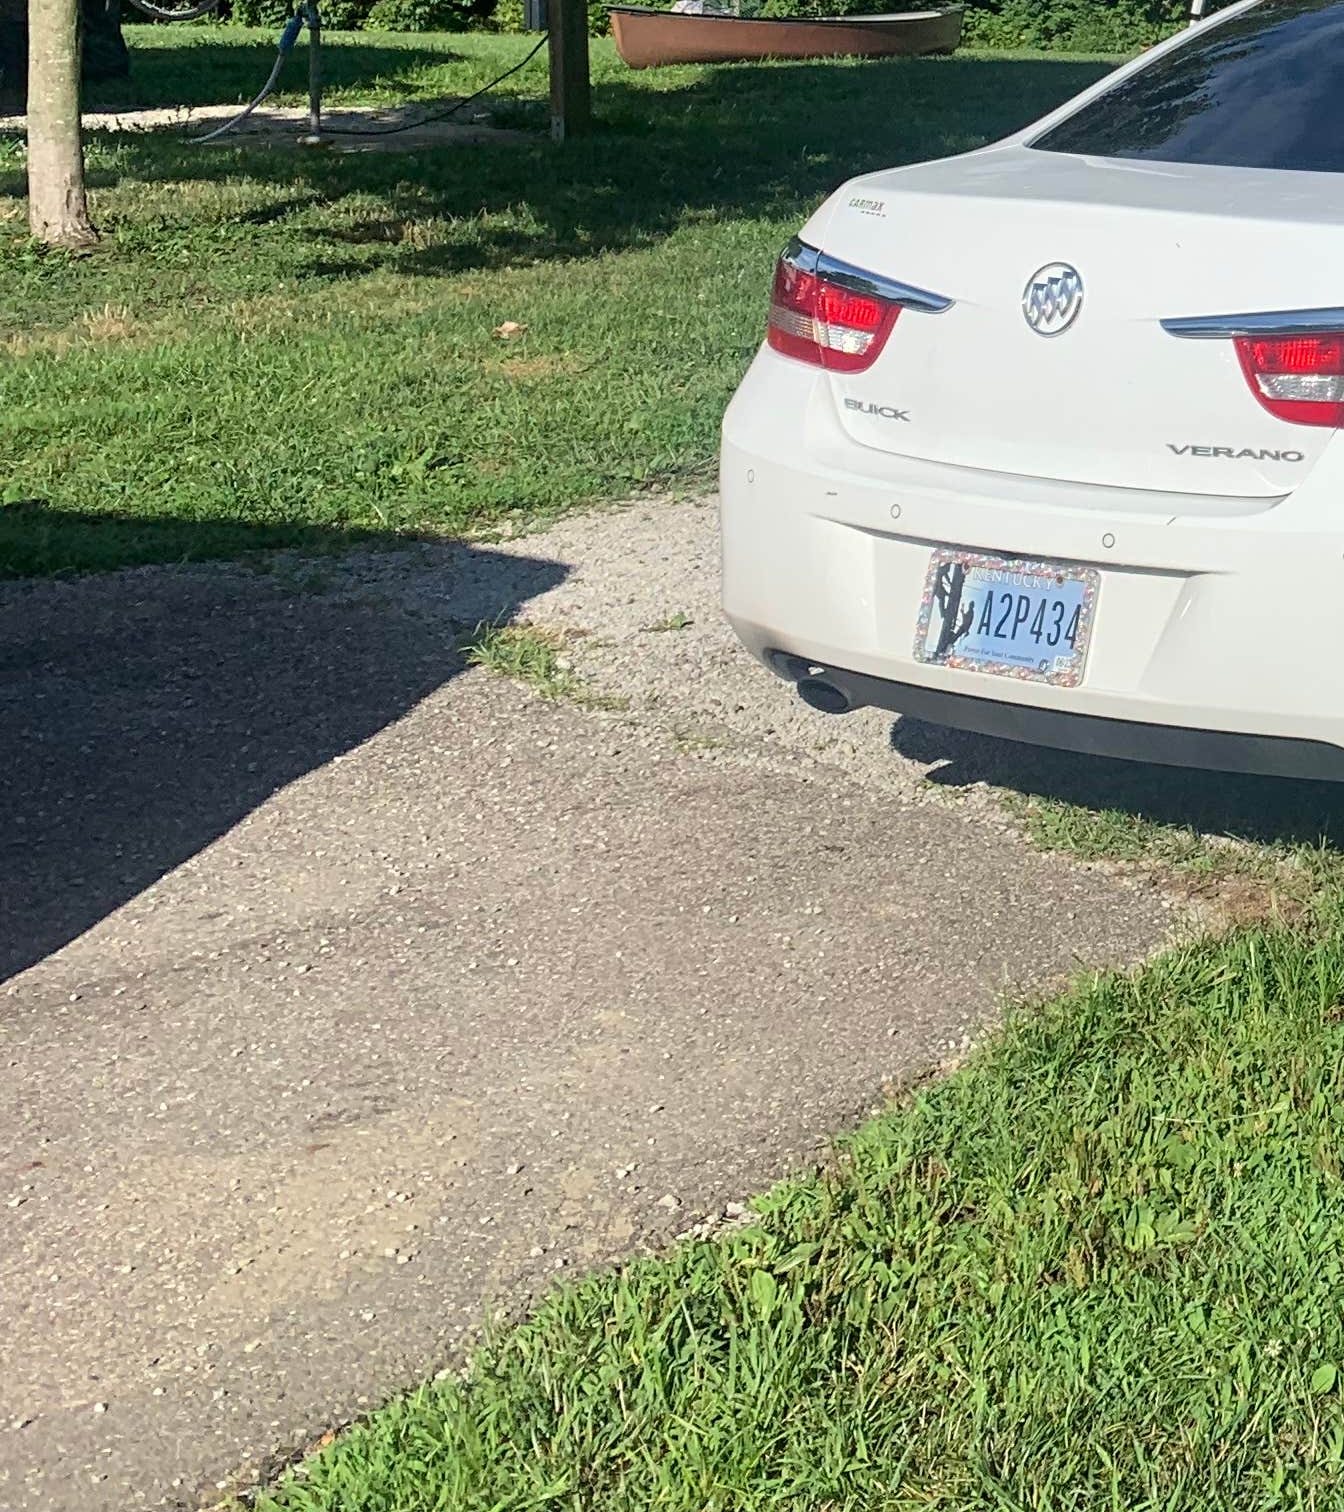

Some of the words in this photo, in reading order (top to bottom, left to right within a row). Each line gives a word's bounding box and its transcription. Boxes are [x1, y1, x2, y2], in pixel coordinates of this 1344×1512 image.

[844, 398, 911, 422] BUICK
[1166, 443, 1304, 462] VERANO
[973, 567, 1056, 590] KENTUCKY
[977, 590, 1082, 650] A2P434
